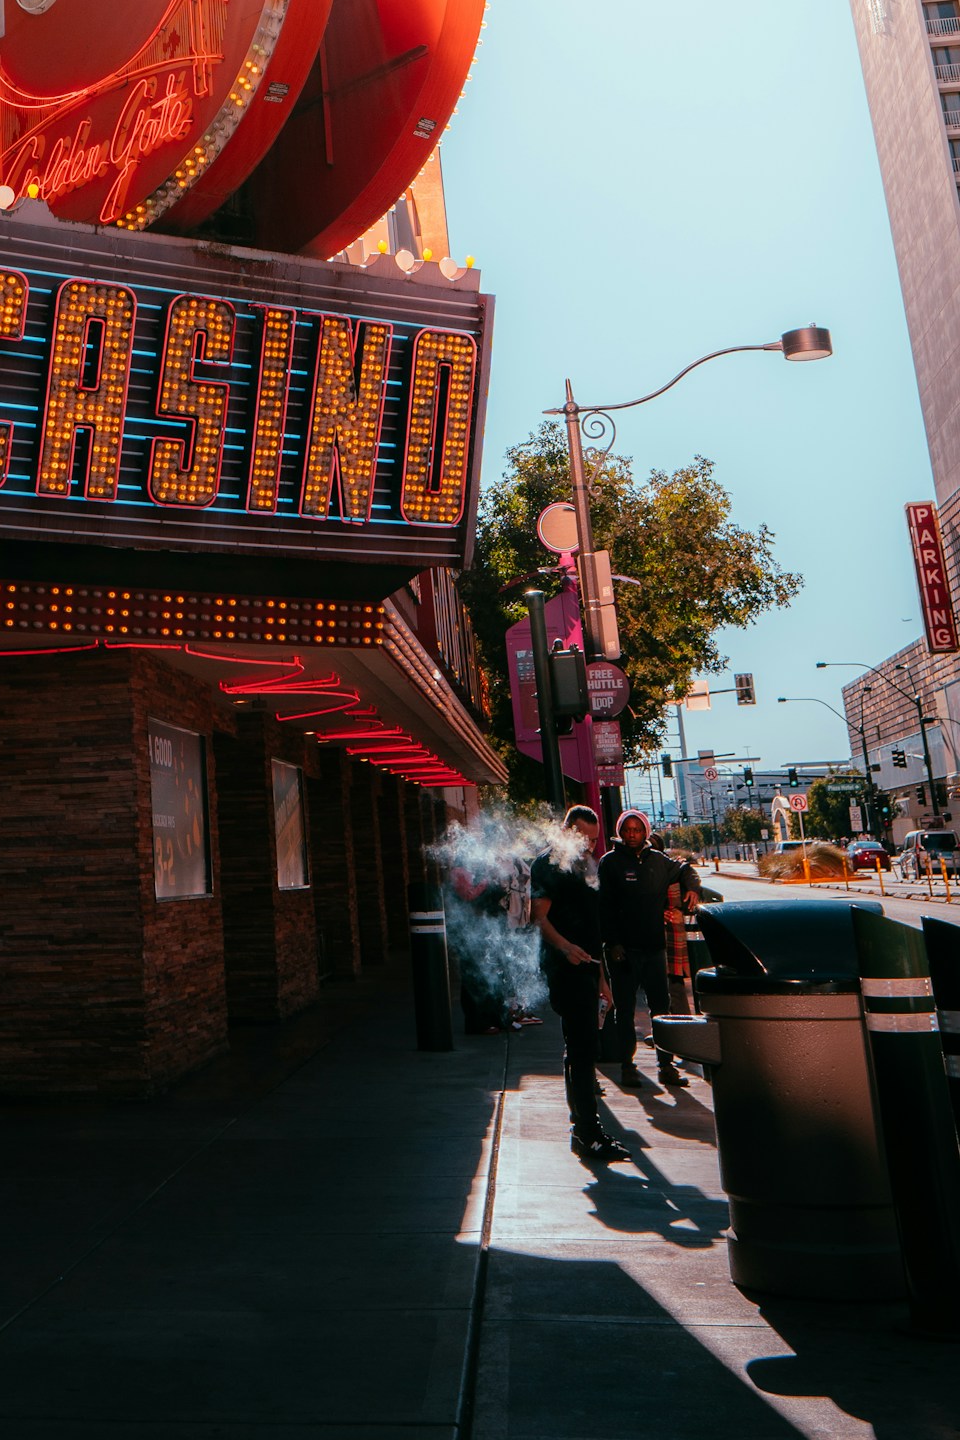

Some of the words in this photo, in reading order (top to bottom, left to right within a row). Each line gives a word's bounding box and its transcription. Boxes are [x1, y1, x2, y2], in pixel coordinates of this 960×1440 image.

[2, 116, 111, 208] Golden
[100, 72, 194, 223] Gate
[915, 507, 952, 645] PARKING
[587, 679, 624, 690] HUTTLE
[589, 670, 614, 679] FREE
[592, 696, 614, 711] LOOP
[155, 736, 173, 768] GOOD
